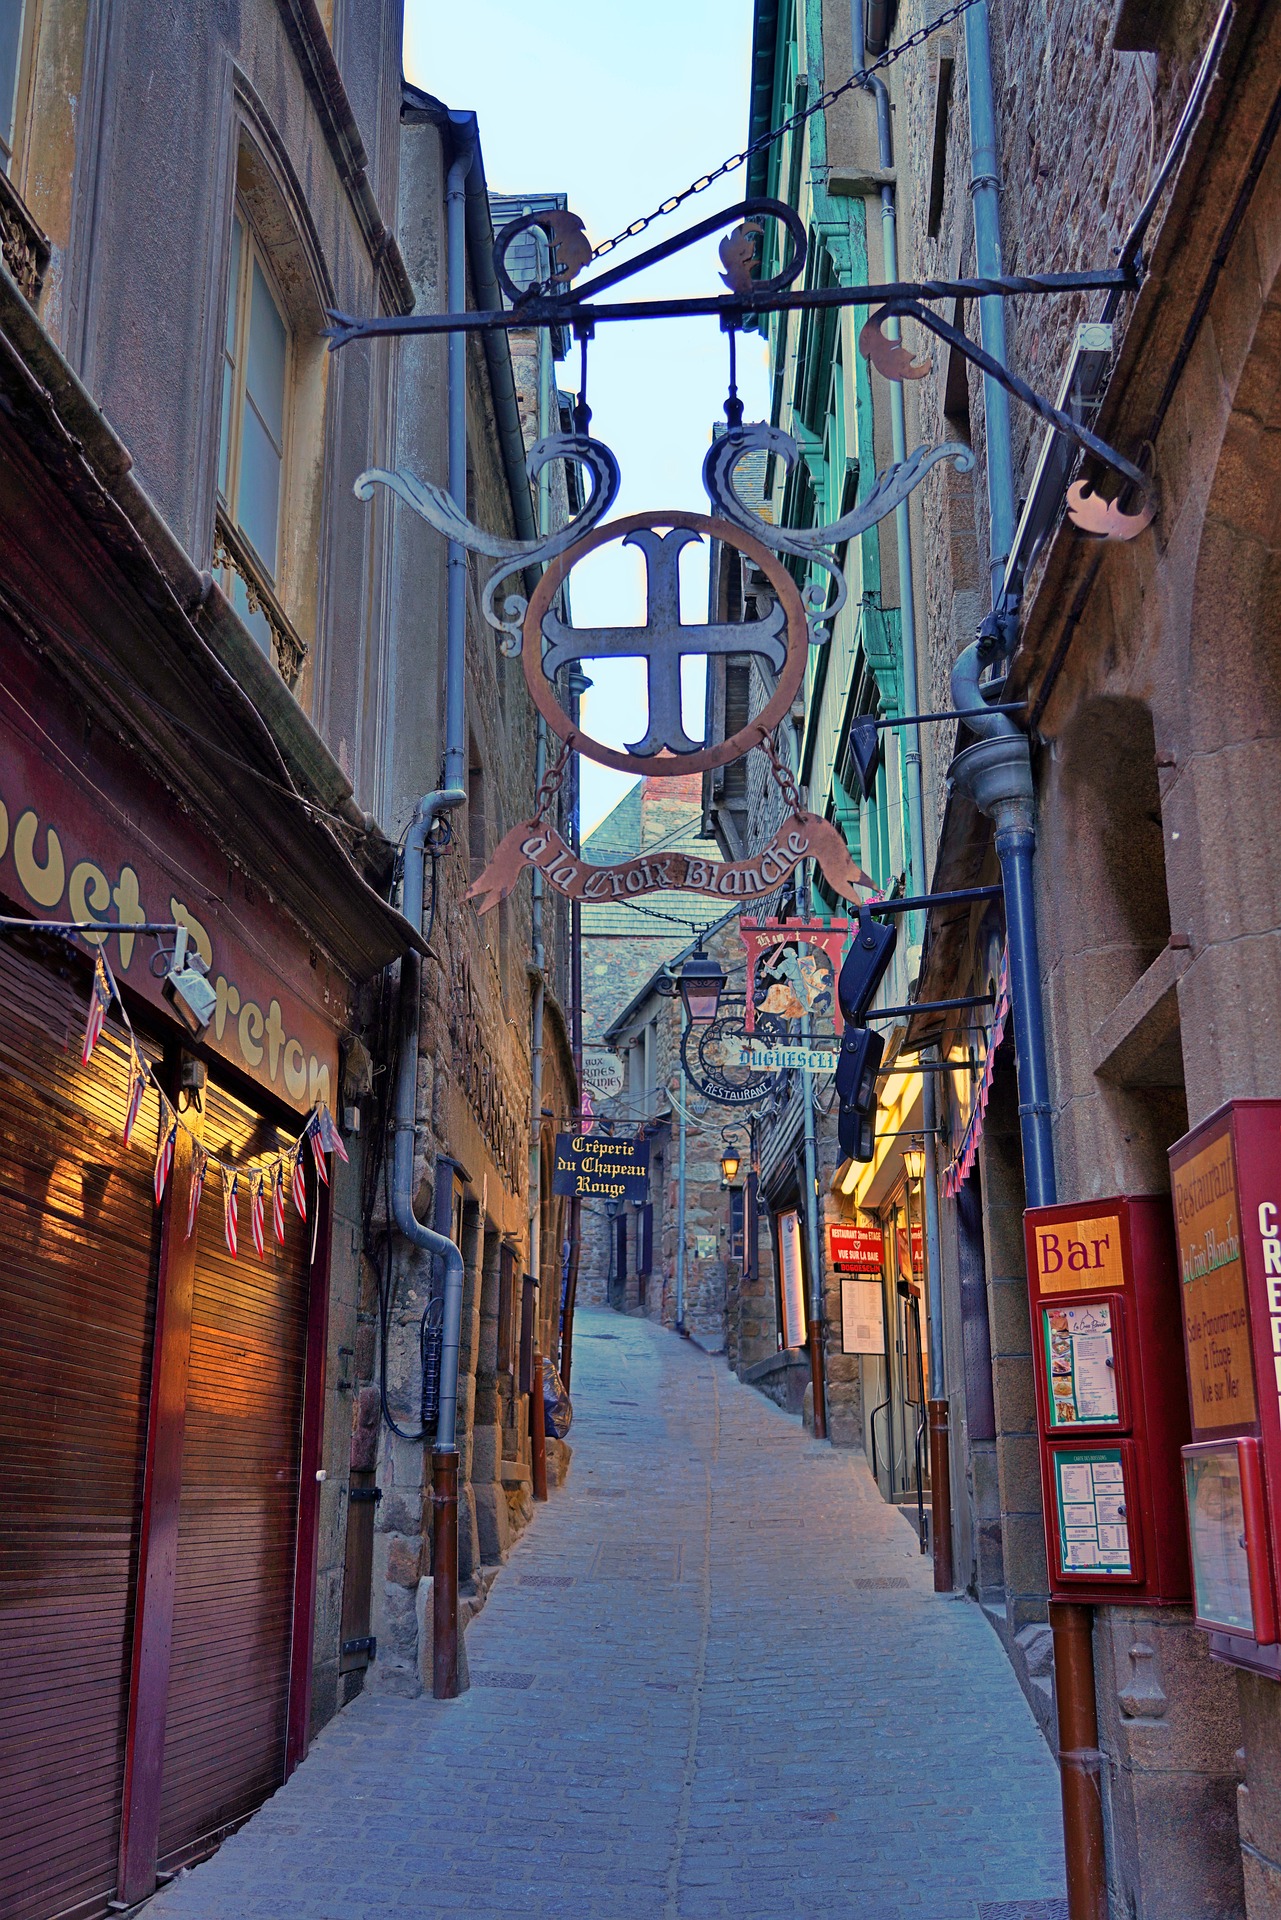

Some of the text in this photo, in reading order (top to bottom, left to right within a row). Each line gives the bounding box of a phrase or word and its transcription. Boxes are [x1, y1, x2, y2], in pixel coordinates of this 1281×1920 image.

[540, 850, 579, 891] la
[576, 859, 673, 899] Croix
[683, 831, 809, 895] Blanche
[739, 1049, 839, 1070] DUGUESCLI
[583, 1066, 616, 1078] RMES
[705, 1081, 768, 1101] RESTAURANT
[572, 1137, 635, 1158] Crêperie
[557, 1157, 646, 1179] du Chapeau
[575, 1176, 626, 1199] Rouge
[1176, 1143, 1234, 1225] Restaurant
[831, 1228, 857, 1239] RESTAURANT
[838, 1249, 879, 1261] VUE SUR LA BAIE
[1039, 1233, 1110, 1274] Bar
[1204, 1214, 1239, 1276] Blanche
[1187, 1304, 1246, 1343] Salle Panoramique
[1200, 1367, 1239, 1403] Vue sur Mer
